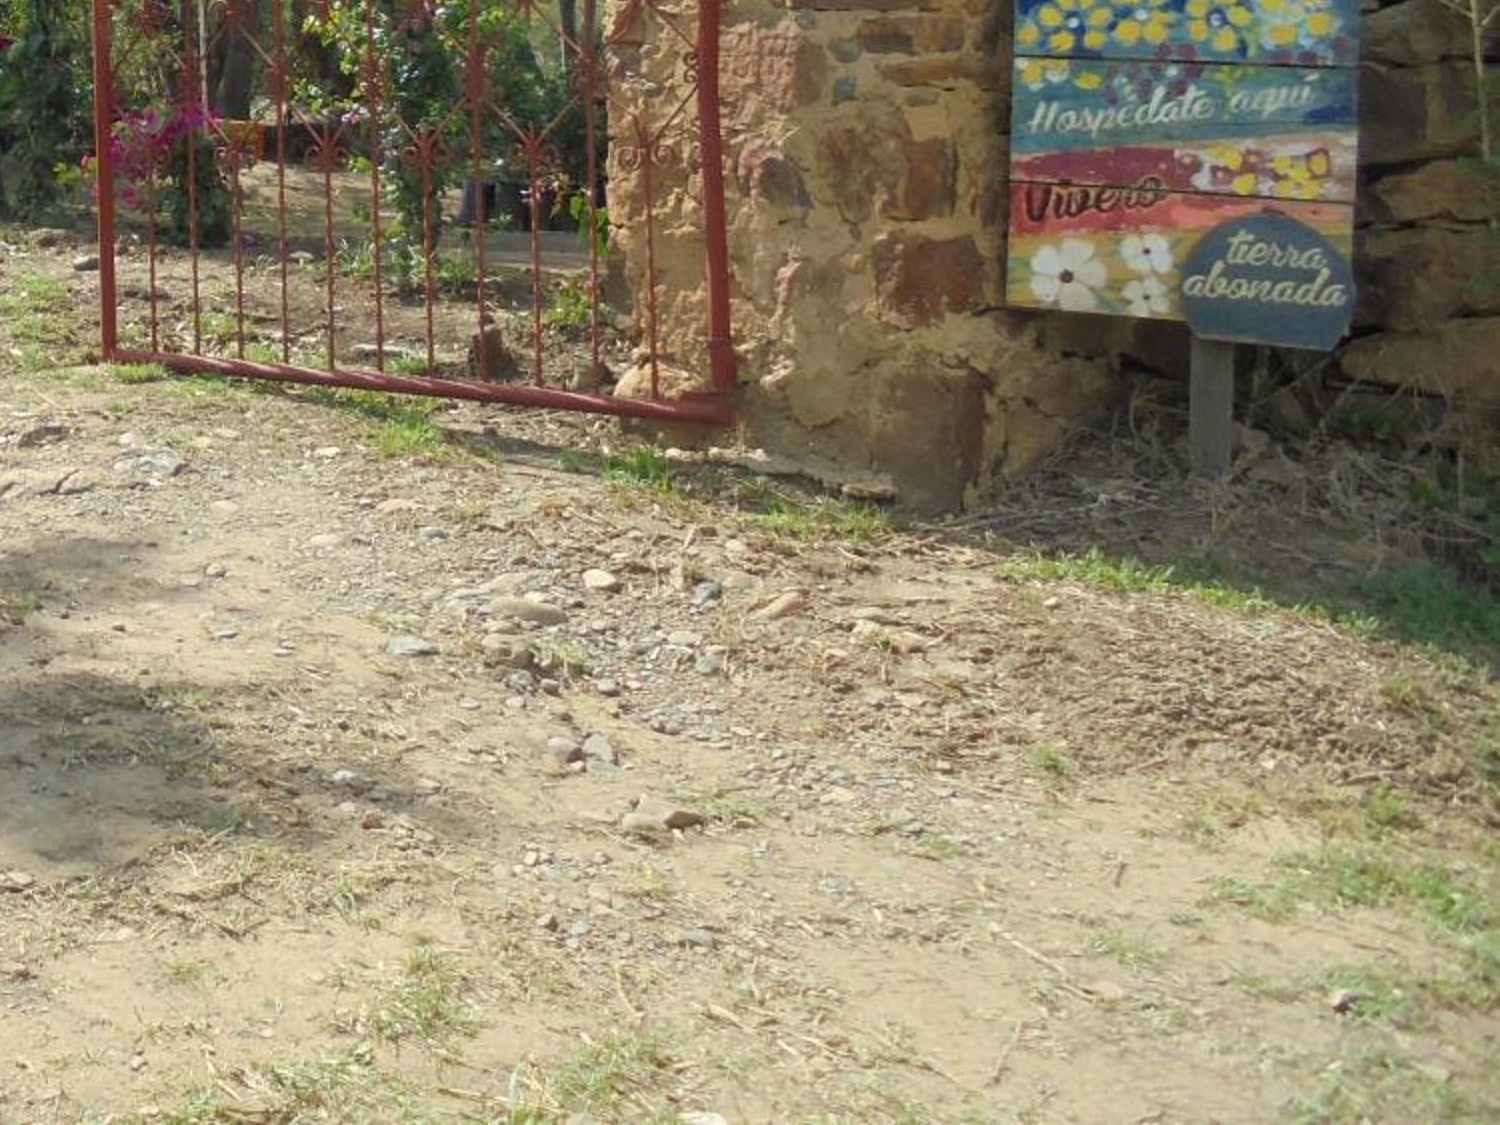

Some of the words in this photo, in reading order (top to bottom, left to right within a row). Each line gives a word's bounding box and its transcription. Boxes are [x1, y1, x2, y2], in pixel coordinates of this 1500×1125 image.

[1230, 72, 1322, 122] aquí
[1025, 177, 1168, 222] Vivero
[1225, 229, 1327, 269] tierra
[1182, 258, 1349, 307] abonada
